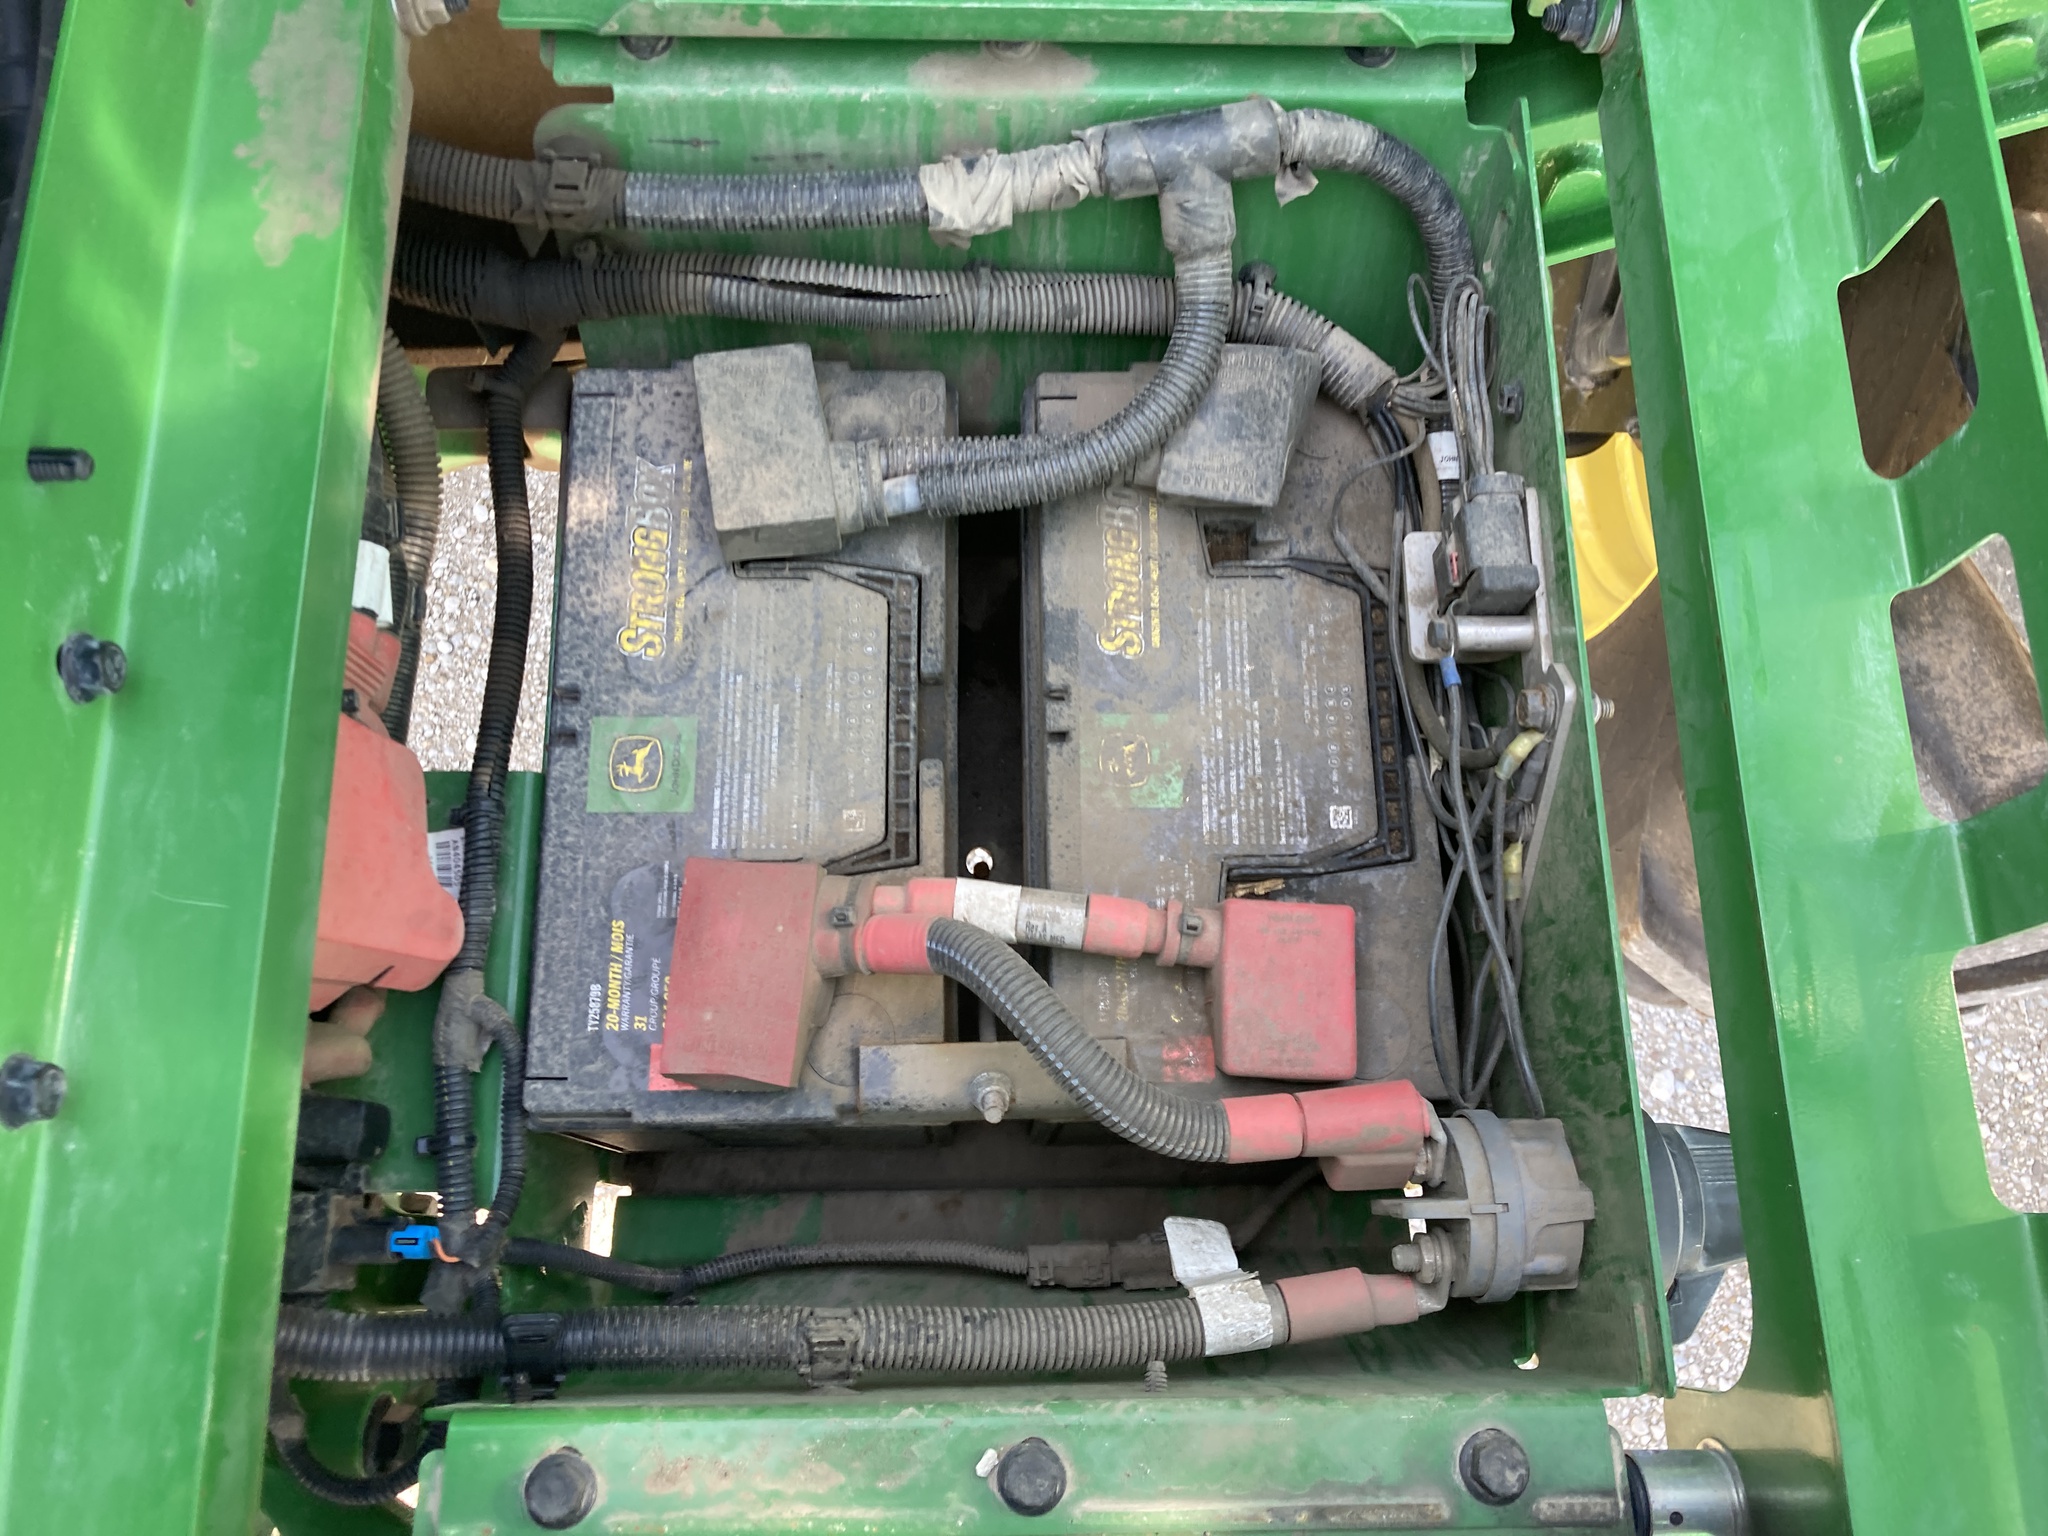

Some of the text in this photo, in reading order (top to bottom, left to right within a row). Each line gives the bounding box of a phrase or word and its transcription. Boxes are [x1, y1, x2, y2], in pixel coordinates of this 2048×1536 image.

[610, 919, 626, 954] MOIS
[605, 962, 623, 1032] 20-MONTH
[622, 933, 635, 1032] WARRANTY/GARANTIE
[588, 983, 602, 1032] TY25879B
[633, 1015, 648, 1032] 31
